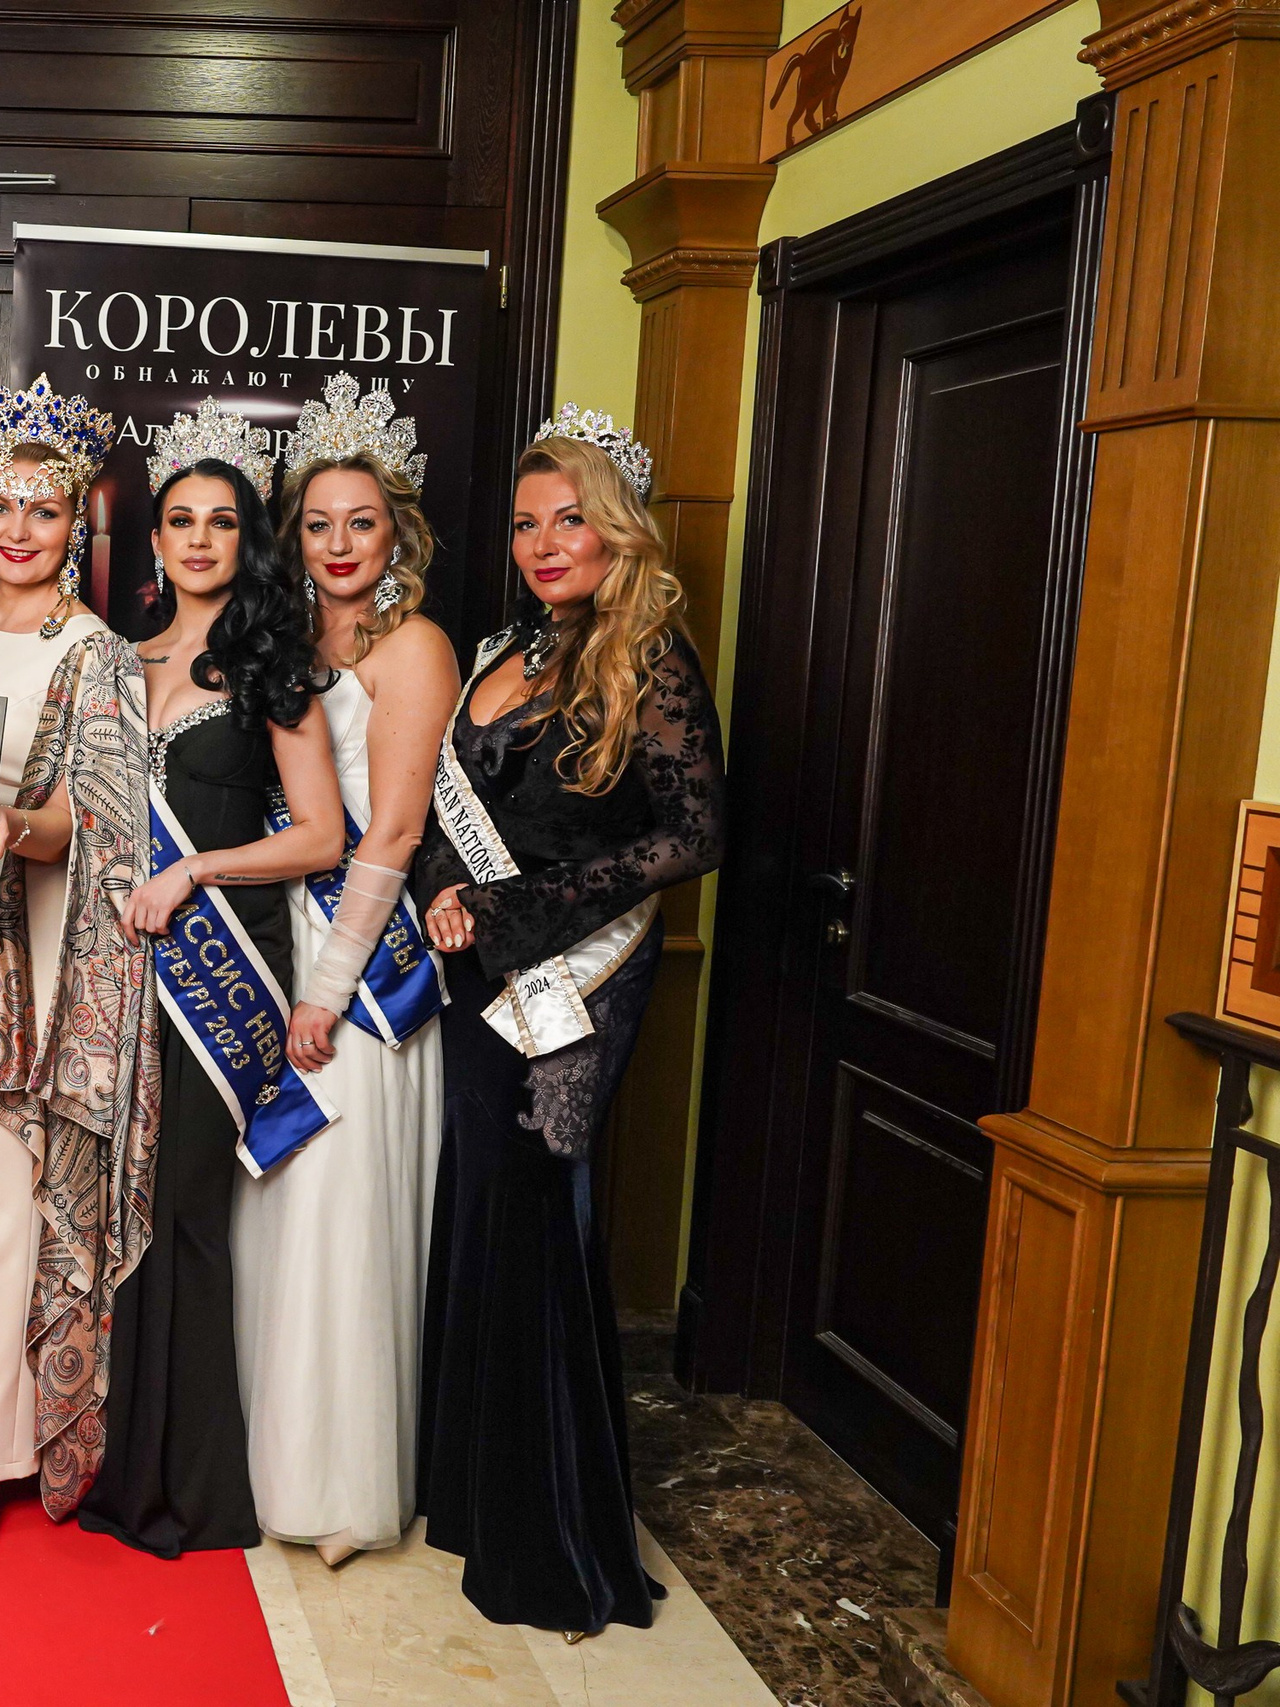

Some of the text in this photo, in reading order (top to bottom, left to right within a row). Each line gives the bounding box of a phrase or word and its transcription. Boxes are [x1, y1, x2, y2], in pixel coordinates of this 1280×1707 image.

[44, 289, 458, 367] КОРОЛЕВЫ
[86, 364, 292, 389] ОБНАЖАЮТ
[451, 806, 497, 884] NATIONS
[154, 936, 251, 1070] ЕРБУРГ 2023
[524, 976, 551, 999] 2024
